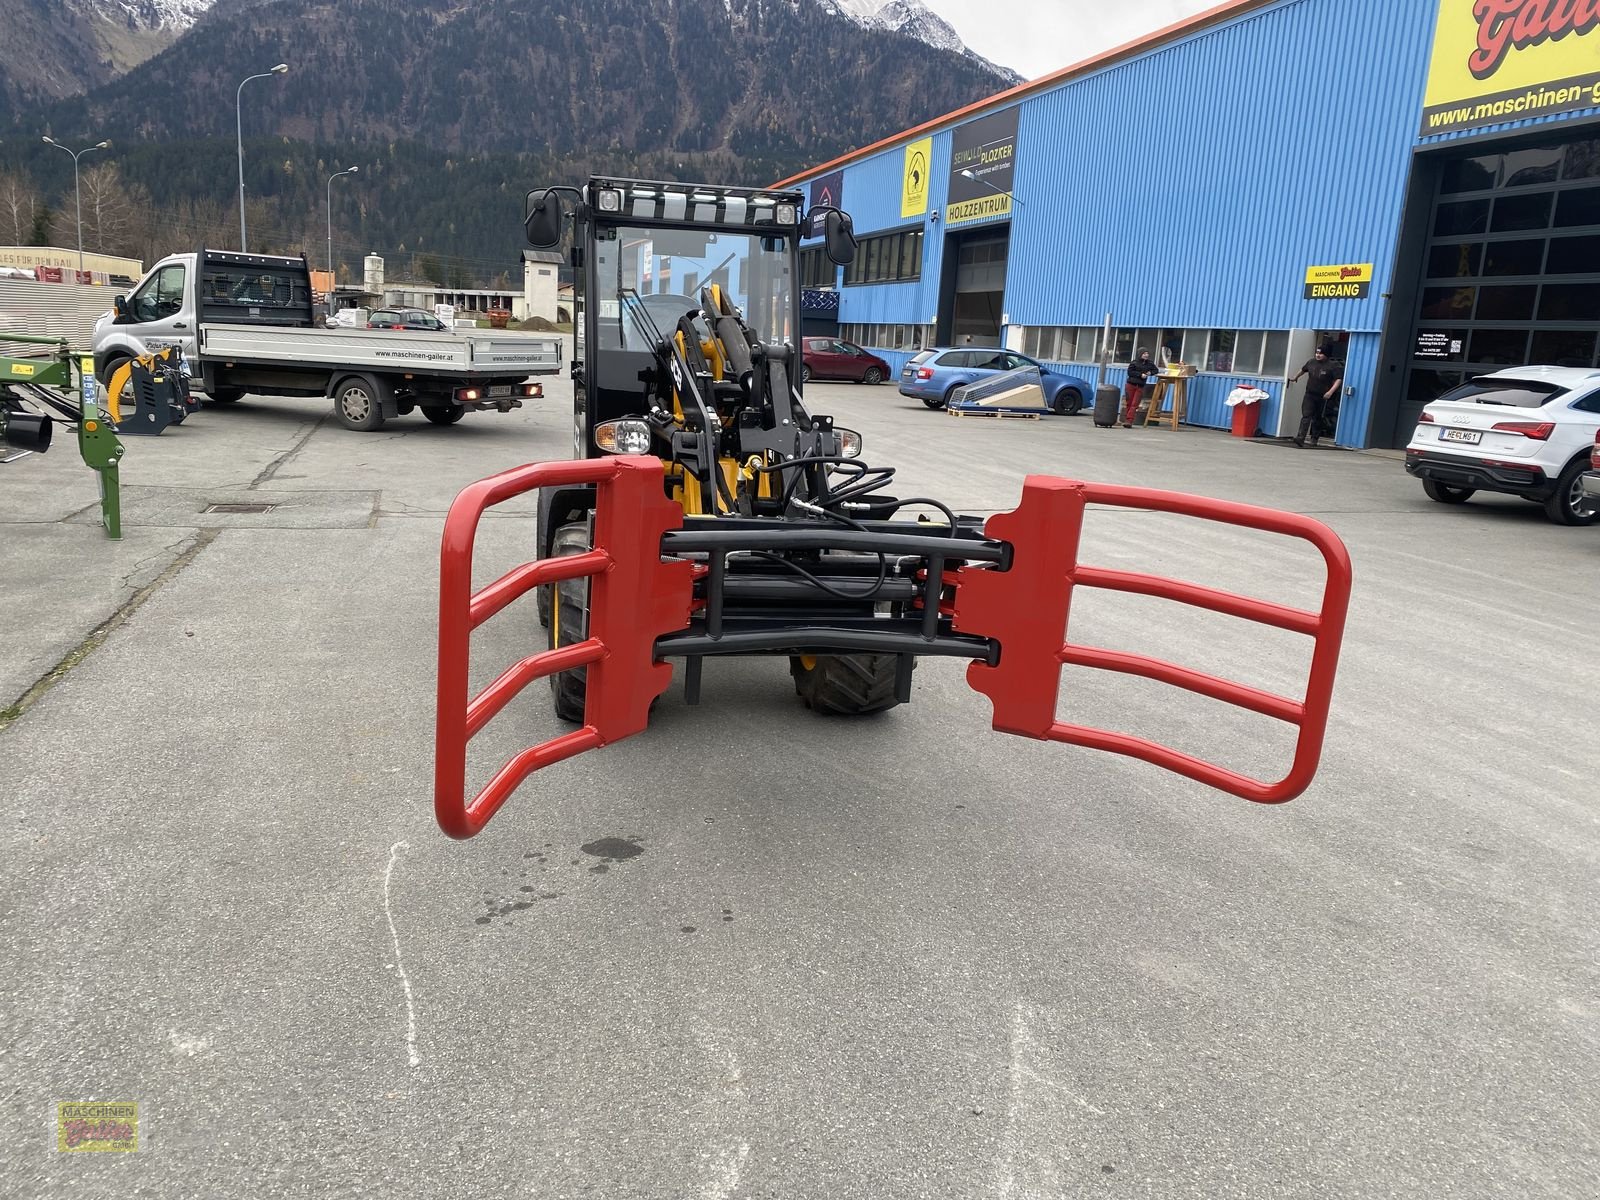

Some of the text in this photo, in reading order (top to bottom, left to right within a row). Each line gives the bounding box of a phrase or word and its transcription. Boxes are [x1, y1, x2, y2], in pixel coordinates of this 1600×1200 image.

[949, 196, 1008, 220] HOLZZENTRUM
[1312, 284, 1359, 296] EINGANG
[375, 350, 453, 361] www.maschinen-gailer.at
[492, 355, 542, 363] www.maschinen-gailer.at
